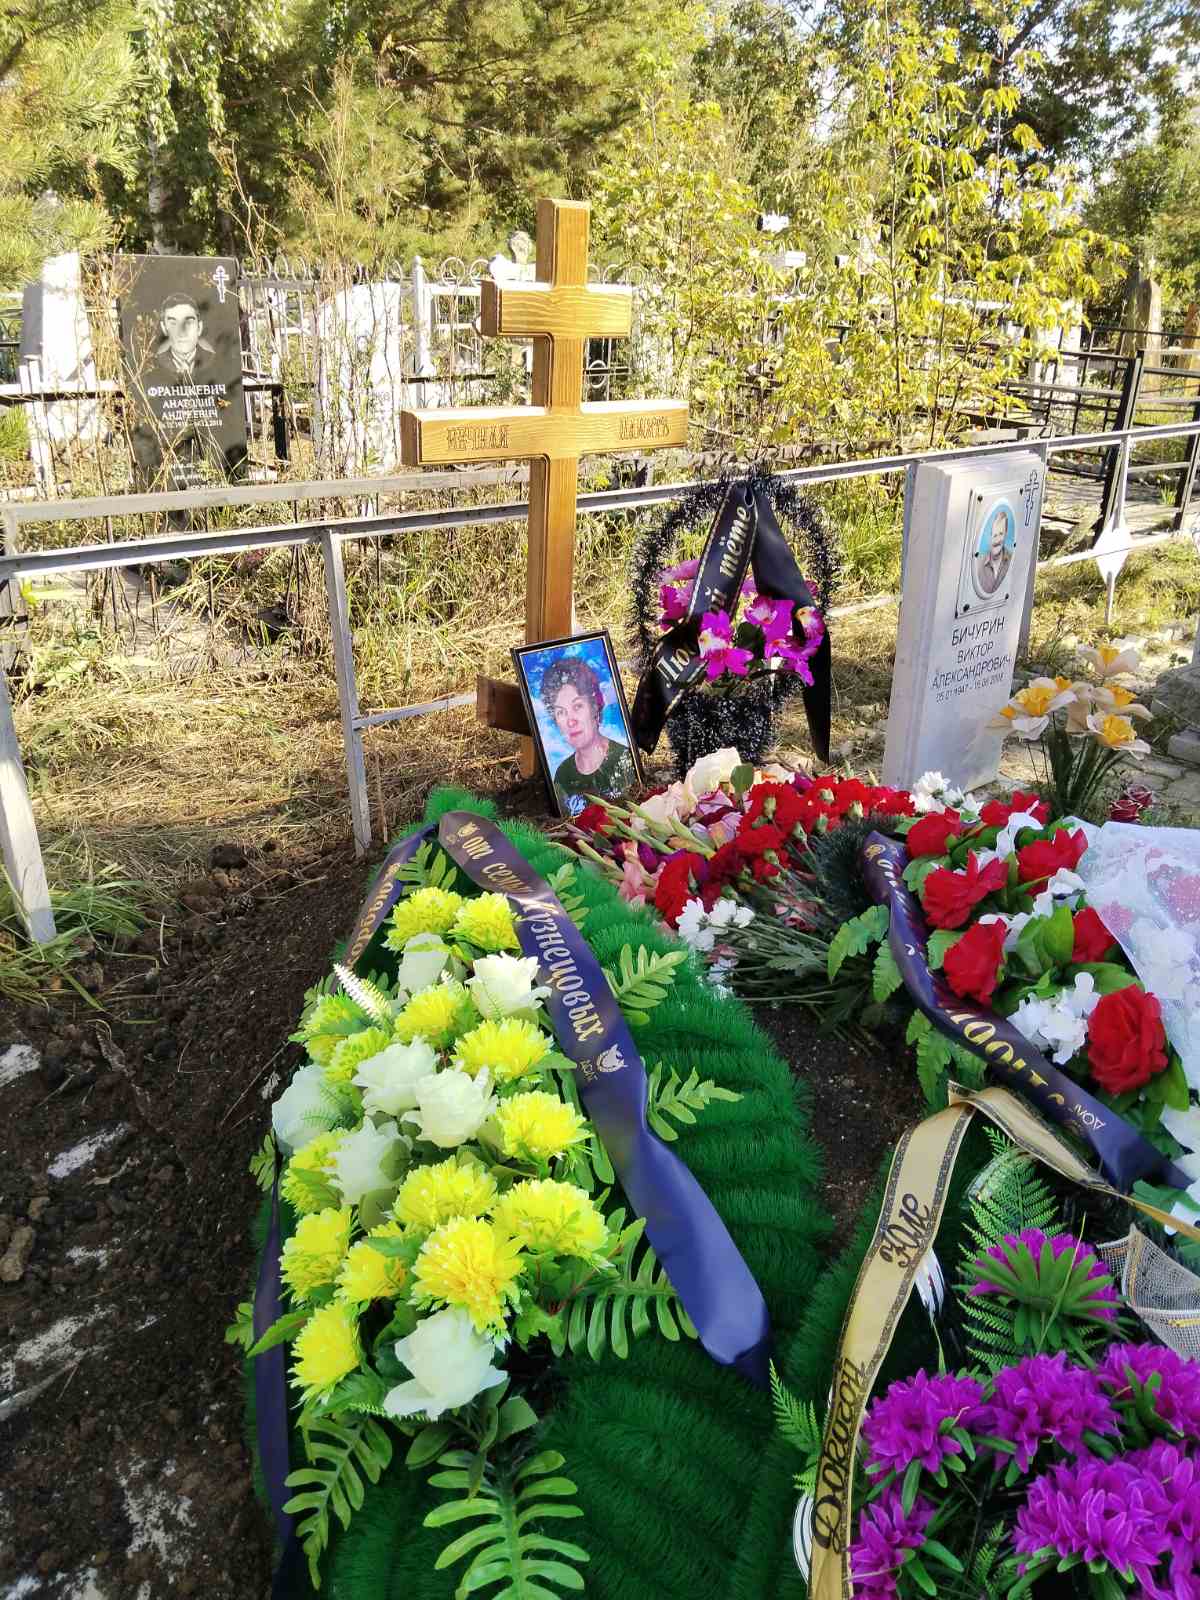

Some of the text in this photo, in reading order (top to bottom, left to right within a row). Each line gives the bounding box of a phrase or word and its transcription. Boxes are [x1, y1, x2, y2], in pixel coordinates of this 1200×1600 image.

[147, 384, 227, 397] ФРАНЦКЕВИЧ
[718, 506, 751, 578] тёте
[951, 616, 1005, 646] БИЧУРИН
[957, 641, 993, 664] ВИКТОР
[932, 655, 1011, 690] АЛЕКСАНДРОВИЧ
[462, 837, 494, 860] от
